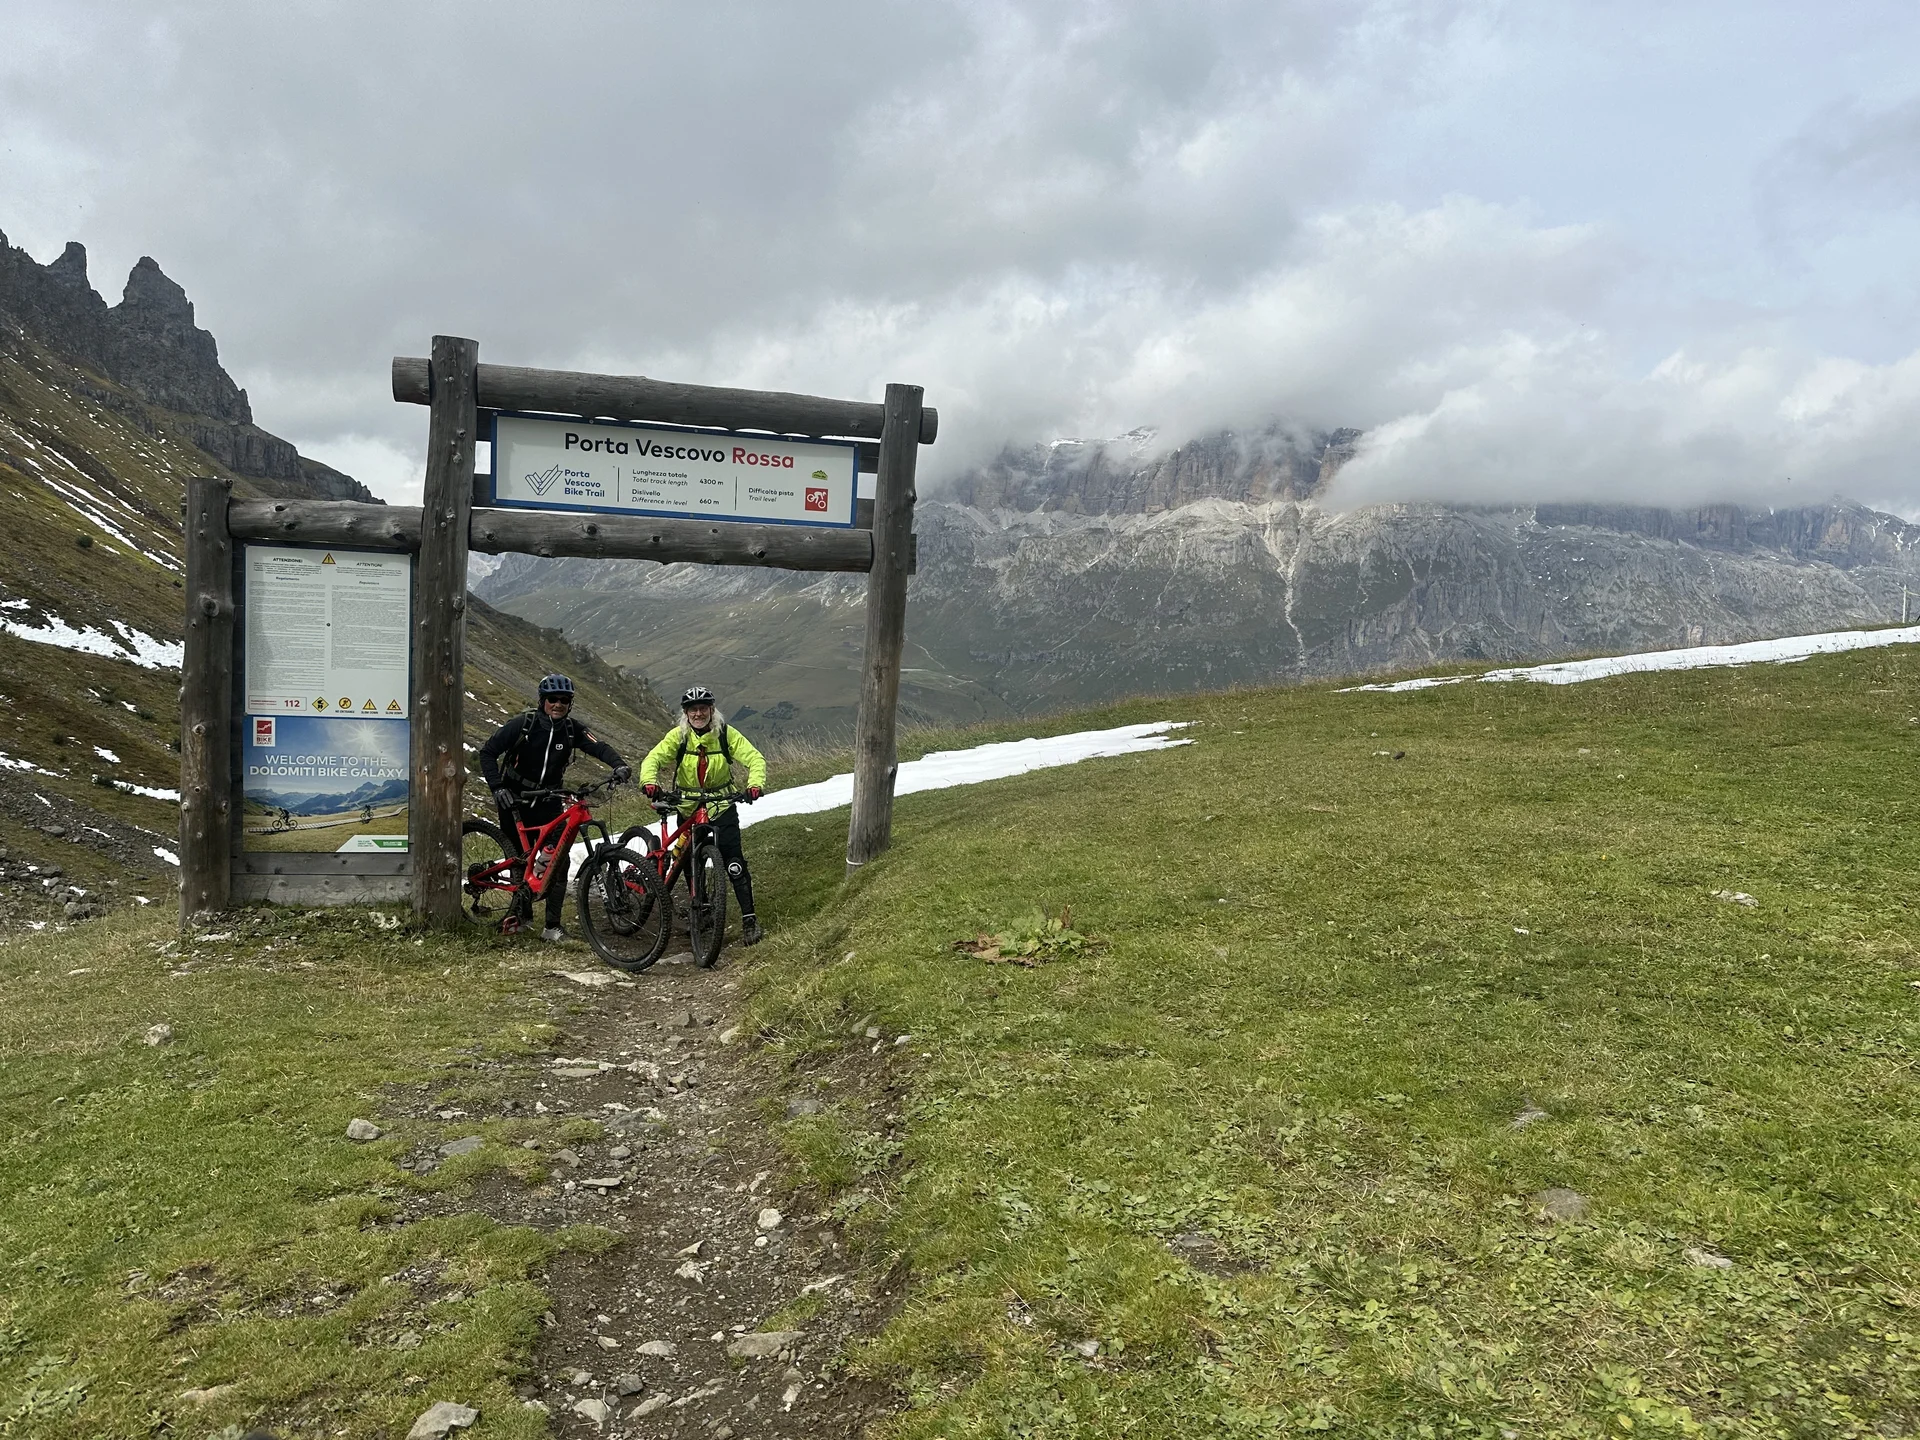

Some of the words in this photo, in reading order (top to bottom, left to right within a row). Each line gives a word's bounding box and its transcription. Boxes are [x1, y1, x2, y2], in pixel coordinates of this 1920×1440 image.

[565, 432, 629, 455] Porta
[635, 438, 726, 463] Vescovo
[732, 446, 794, 469] Rossa
[564, 469, 590, 478] Porta
[632, 469, 667, 477] Lunghezza
[668, 471, 688, 479] totale
[564, 478, 601, 488] Vescovo
[667, 479, 688, 487] length
[564, 487, 584, 496] Bike
[585, 488, 605, 498] Trail
[631, 489, 661, 497] Dislivello
[748, 487, 778, 495] Difficoltà
[631, 496, 665, 505] Difference
[284, 699, 300, 708] 112
[265, 754, 337, 766] WELCOME
[340, 756, 359, 766] TO
[362, 756, 388, 767] THE
[249, 766, 315, 777] DOLOMITI
[317, 767, 347, 777] BIKE
[350, 768, 404, 778] GALAXY
